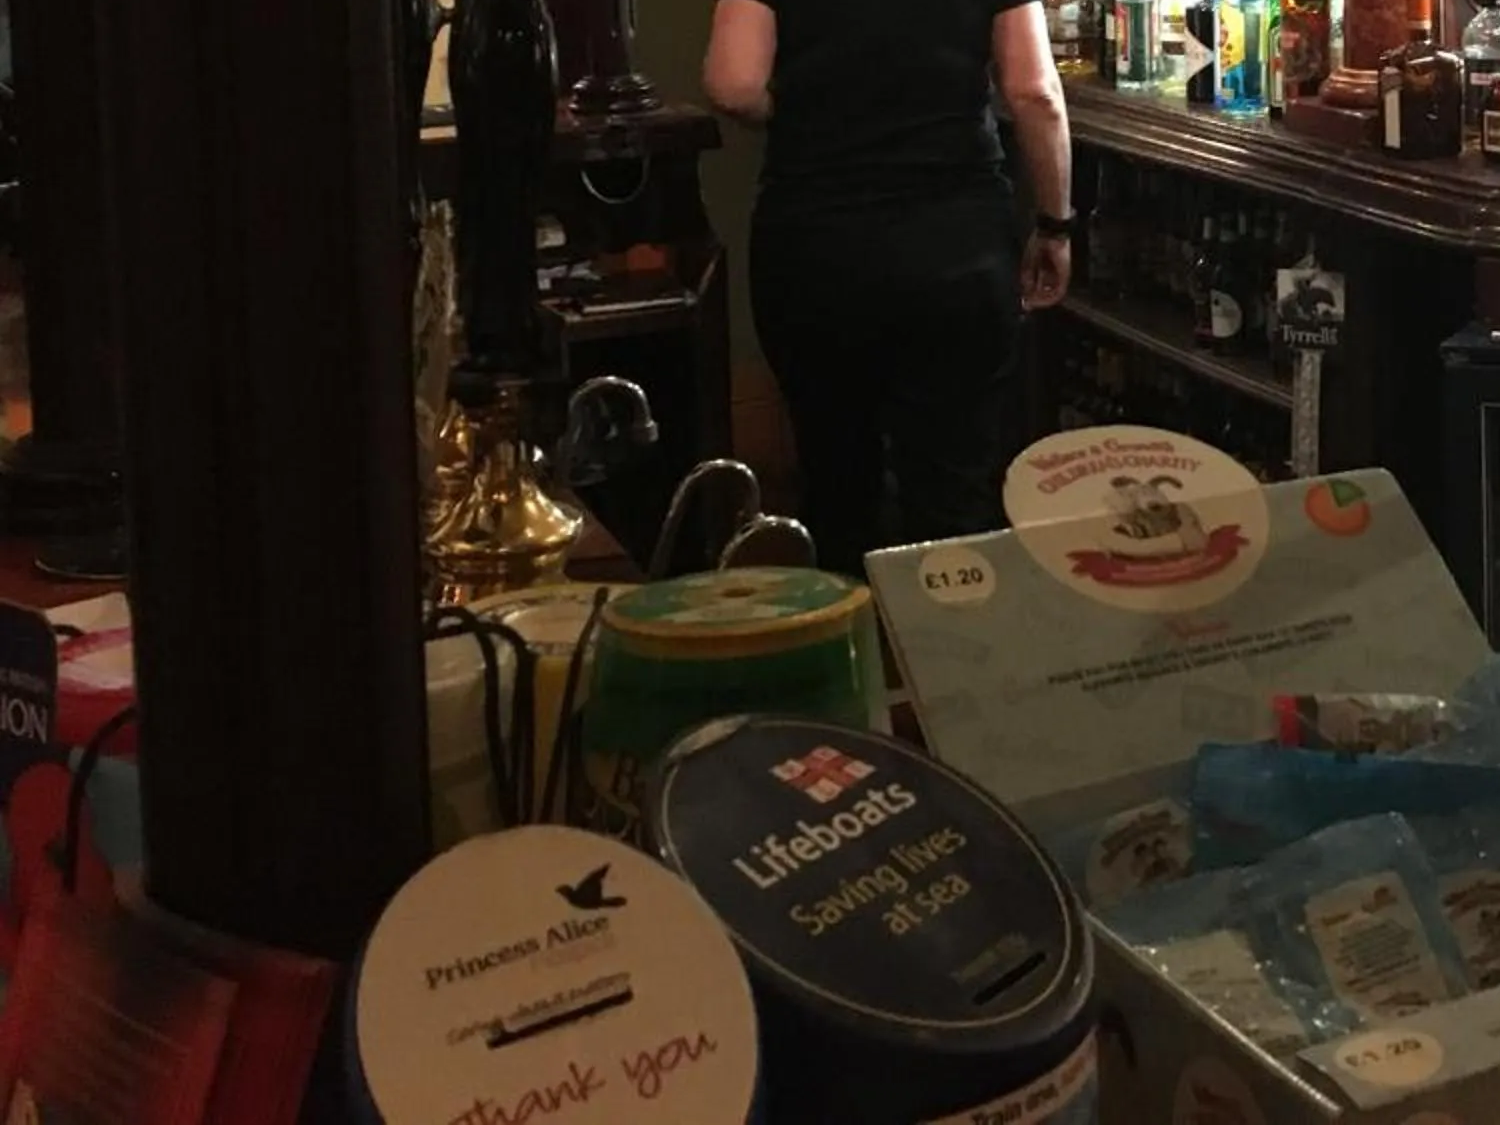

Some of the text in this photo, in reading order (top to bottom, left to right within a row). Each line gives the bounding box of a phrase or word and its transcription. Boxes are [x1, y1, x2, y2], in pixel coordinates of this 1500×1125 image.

[732, 781, 918, 891] Lifeboats
[789, 826, 968, 937] Saving lives
[882, 873, 971, 936] at sea
[425, 937, 541, 992] Princess
[546, 914, 611, 951] Alice
[621, 1032, 718, 1100] you
